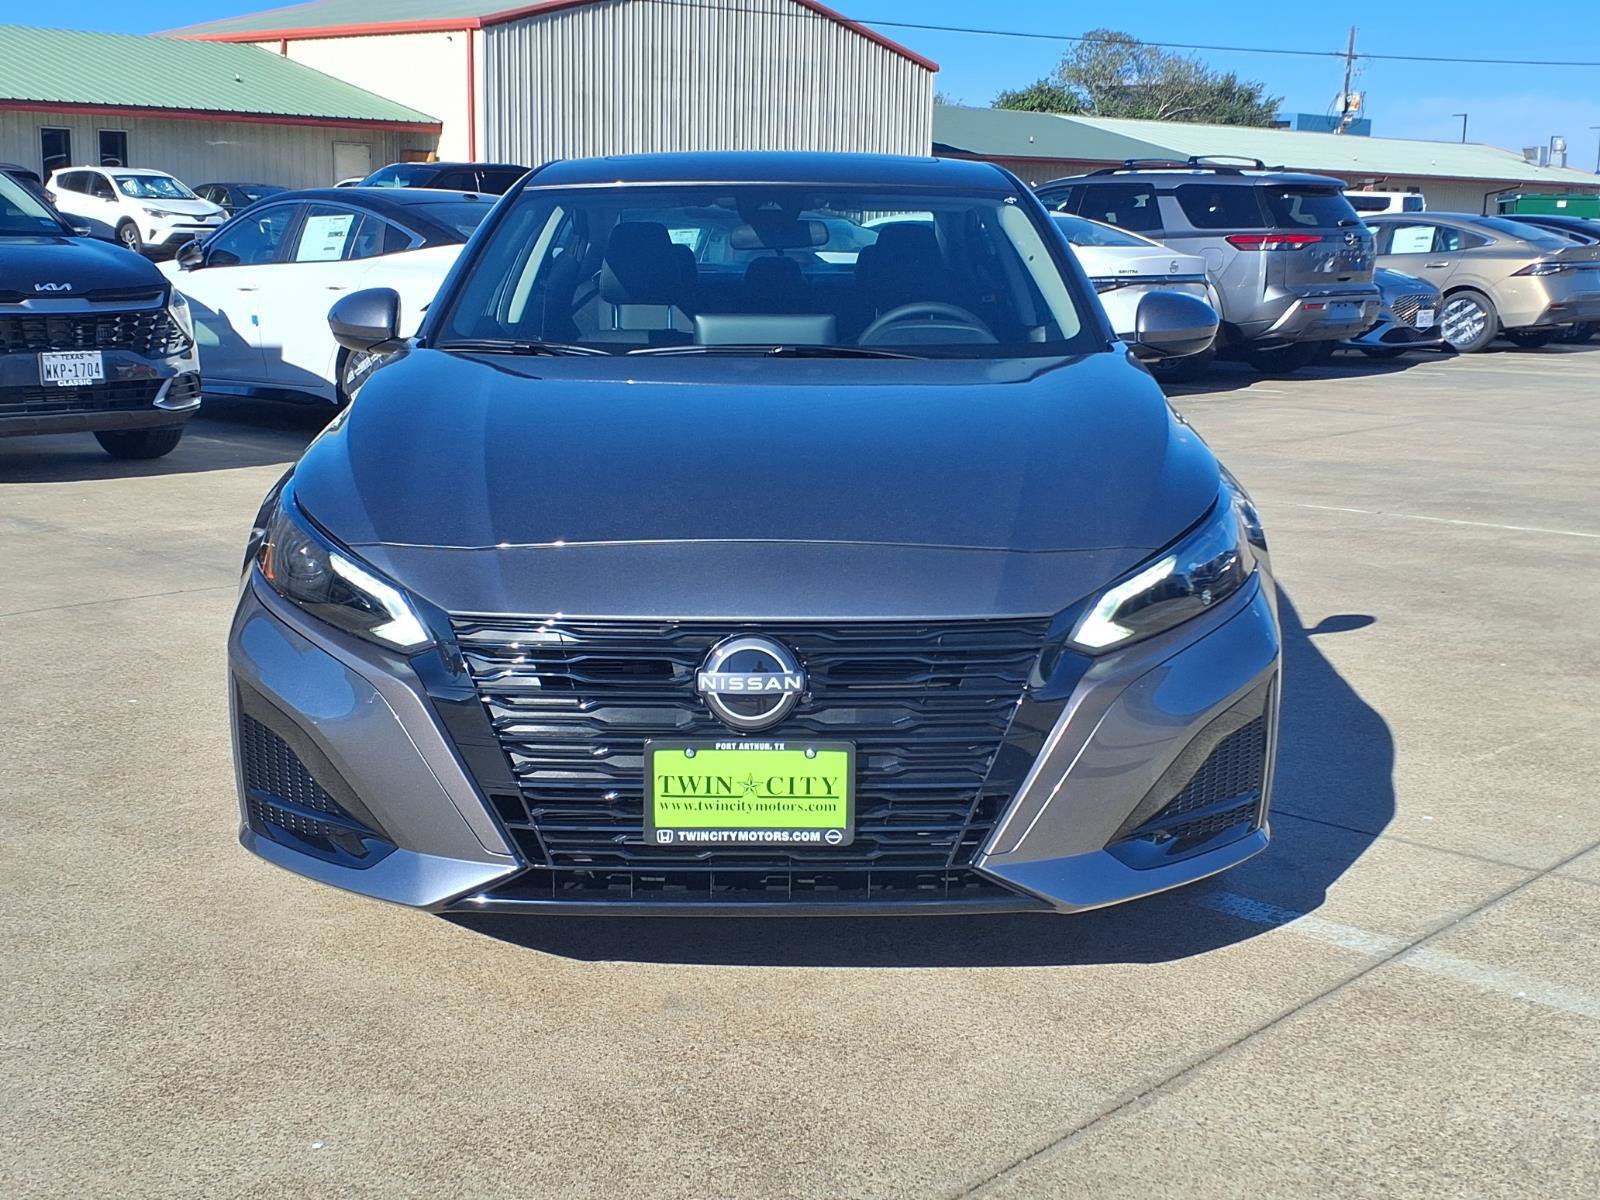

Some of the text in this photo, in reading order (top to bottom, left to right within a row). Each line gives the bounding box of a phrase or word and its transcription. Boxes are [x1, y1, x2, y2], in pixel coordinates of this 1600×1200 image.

[61, 353, 85, 361] TEXAS
[57, 379, 93, 387] CLASSIC
[701, 676, 800, 690] NISSAN
[715, 742, 737, 750] PORT
[774, 742, 785, 750] TX
[658, 774, 838, 795] TWIN CITY
[660, 800, 836, 814] www.twincitymotors.com
[677, 831, 821, 842] TWINCITYMOTORS.COM
